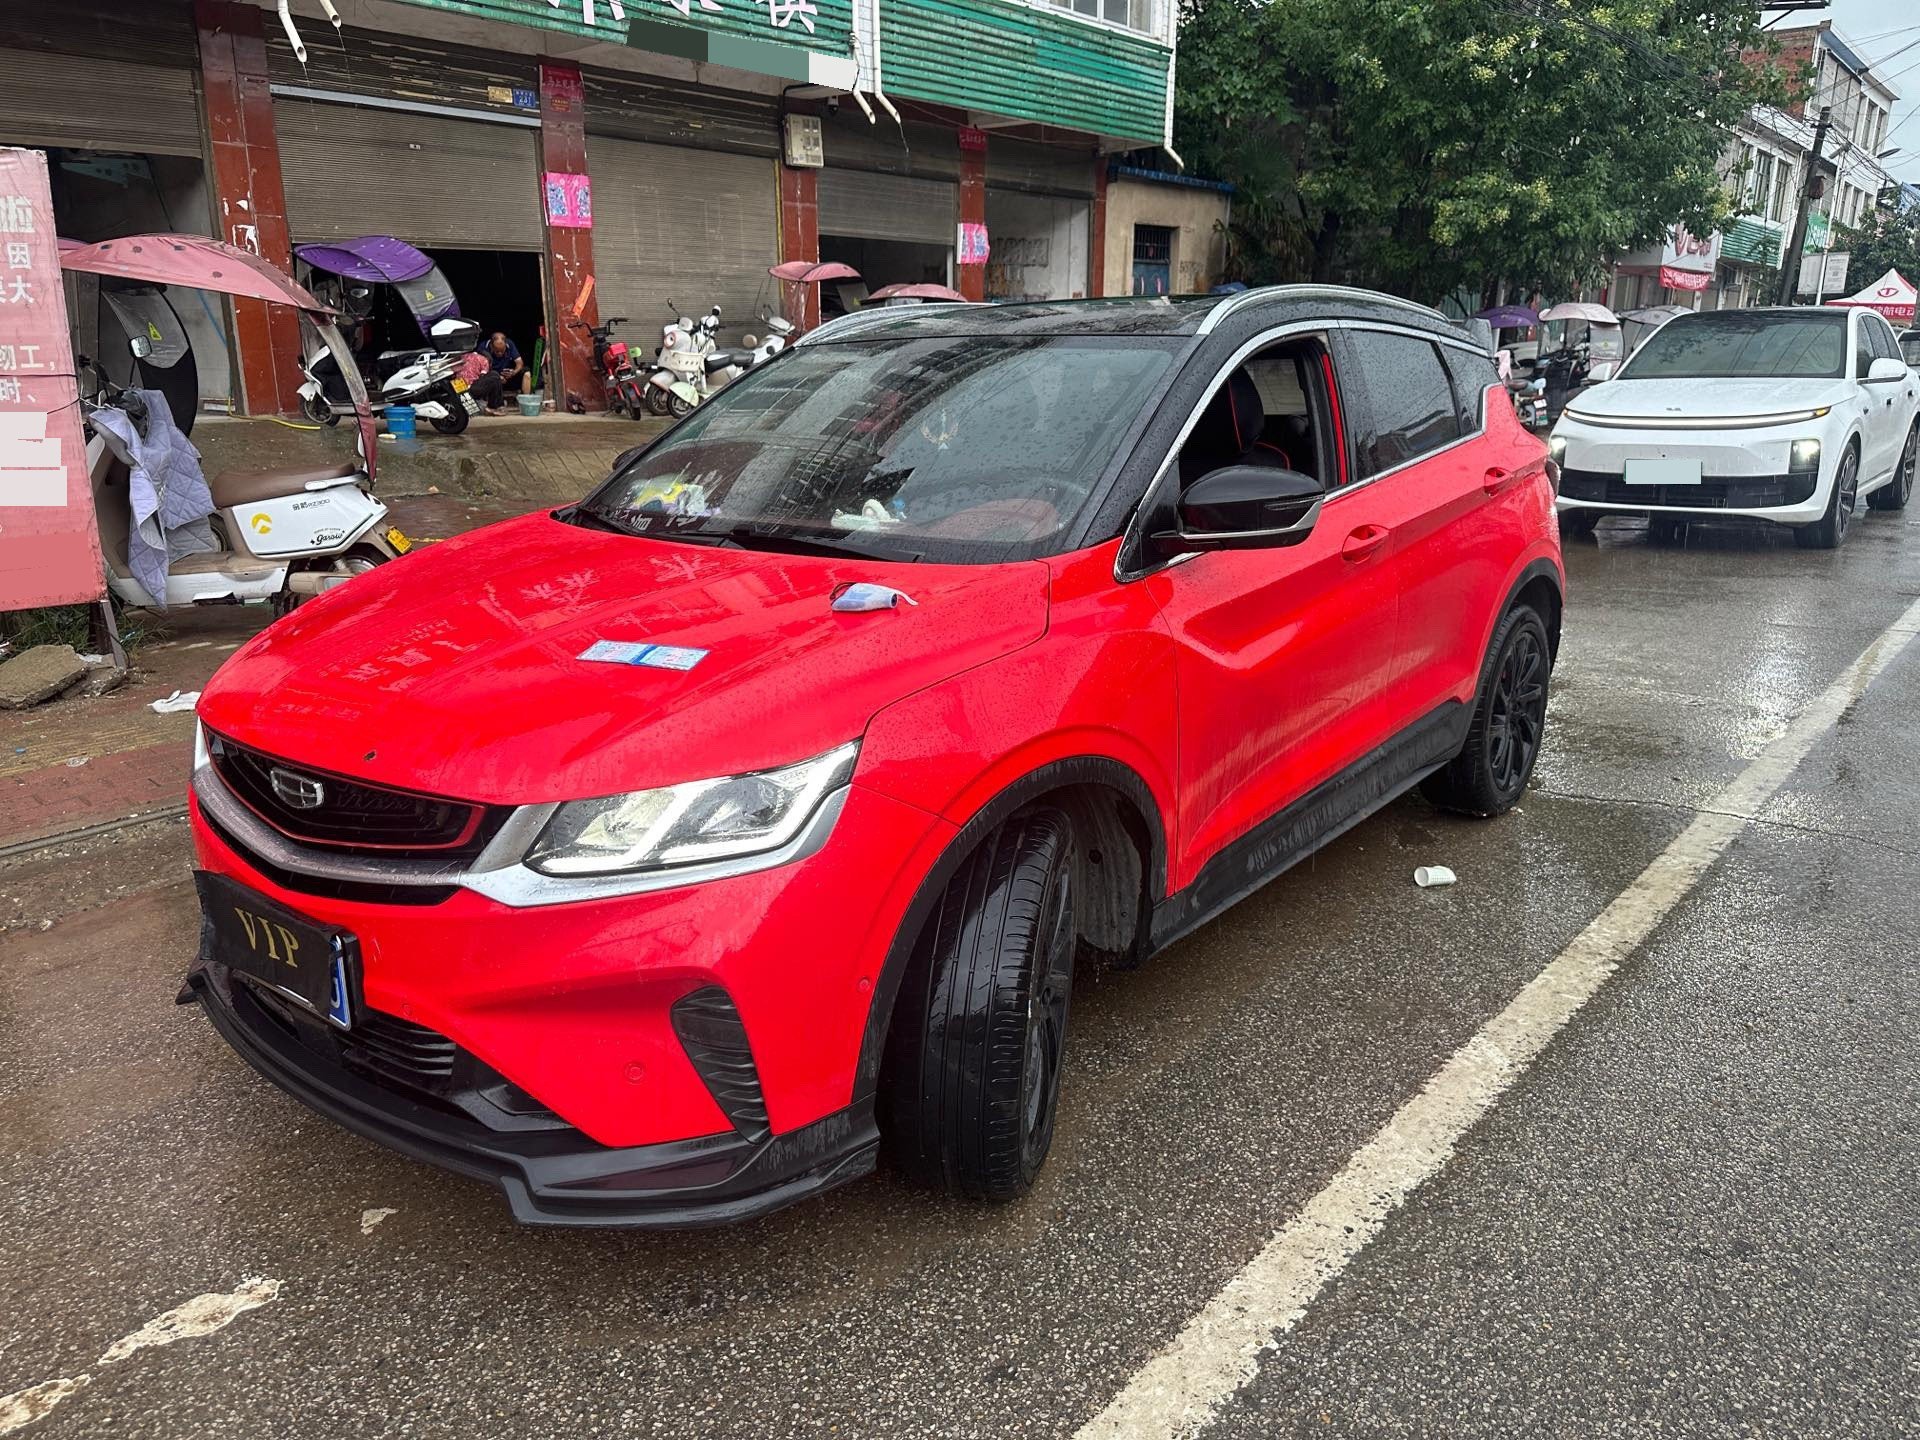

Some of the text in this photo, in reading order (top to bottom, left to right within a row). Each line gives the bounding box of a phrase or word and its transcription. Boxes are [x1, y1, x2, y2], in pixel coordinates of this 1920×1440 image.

[7, 242, 31, 269] 因
[0, 275, 34, 303] 大
[234, 907, 299, 968] VIP
